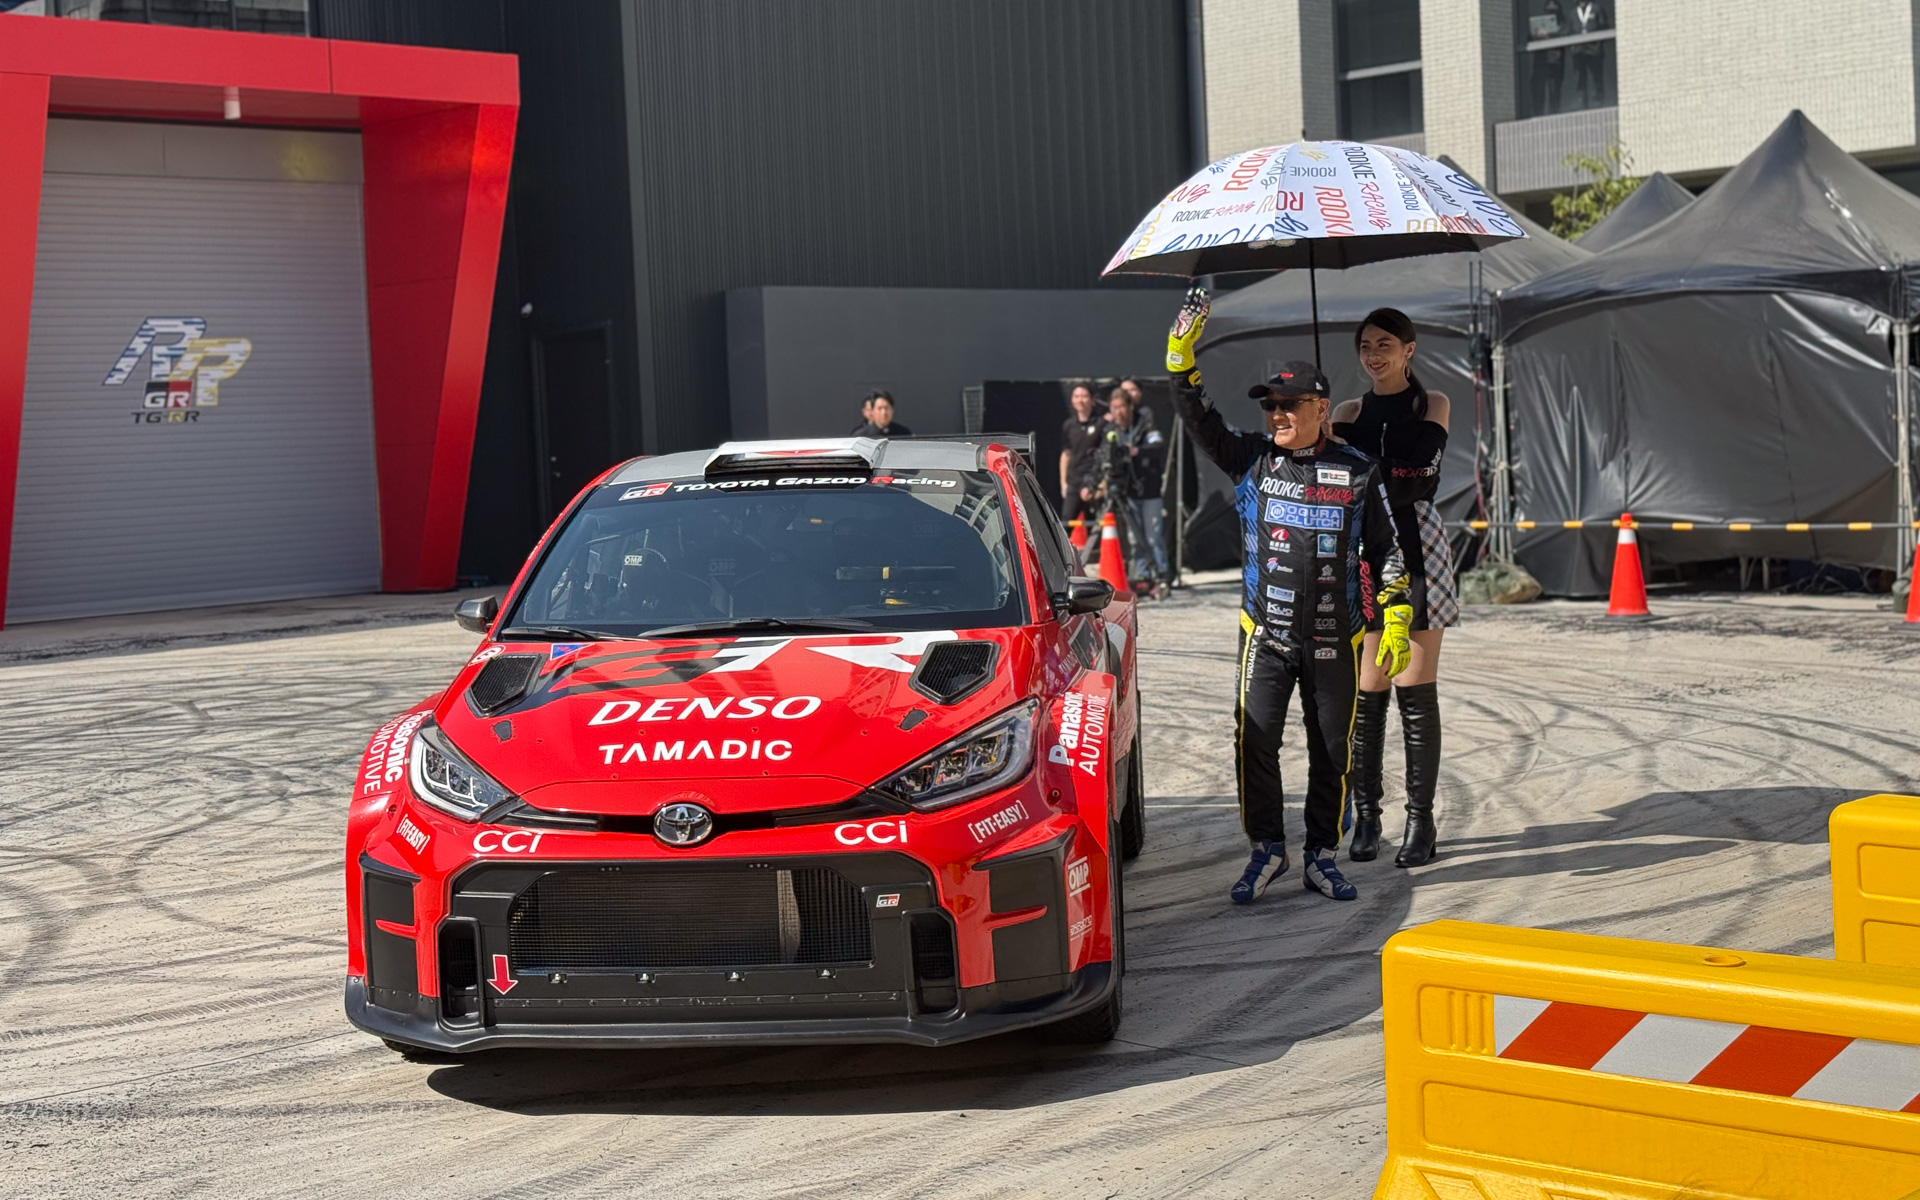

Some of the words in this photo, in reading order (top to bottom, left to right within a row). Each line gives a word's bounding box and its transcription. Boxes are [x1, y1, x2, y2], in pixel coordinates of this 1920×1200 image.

[1290, 166, 1337, 178] ROOKIE
[1342, 146, 1377, 180] ROOKIE
[1358, 181, 1392, 231] RACING
[1398, 181, 1421, 212] ROOKIE
[1171, 207, 1215, 223] ROOKIE
[1212, 200, 1256, 218] RACING
[144, 391, 191, 408] GR
[673, 479, 769, 493] TOYOTA
[776, 476, 867, 487] GAZOO
[871, 476, 957, 489] Racing
[1259, 477, 1305, 499] ROOKIE
[1305, 486, 1354, 504] RACING
[1285, 514, 1340, 528] CLUTCH
[1286, 506, 1340, 519] OGURA
[624, 555, 644, 566] OMP
[708, 561, 736, 573] OMP
[1359, 560, 1375, 622] RACING
[588, 695, 822, 727] DENSO
[599, 739, 793, 765] TAMADIC
[1068, 862, 1090, 890] OMP
